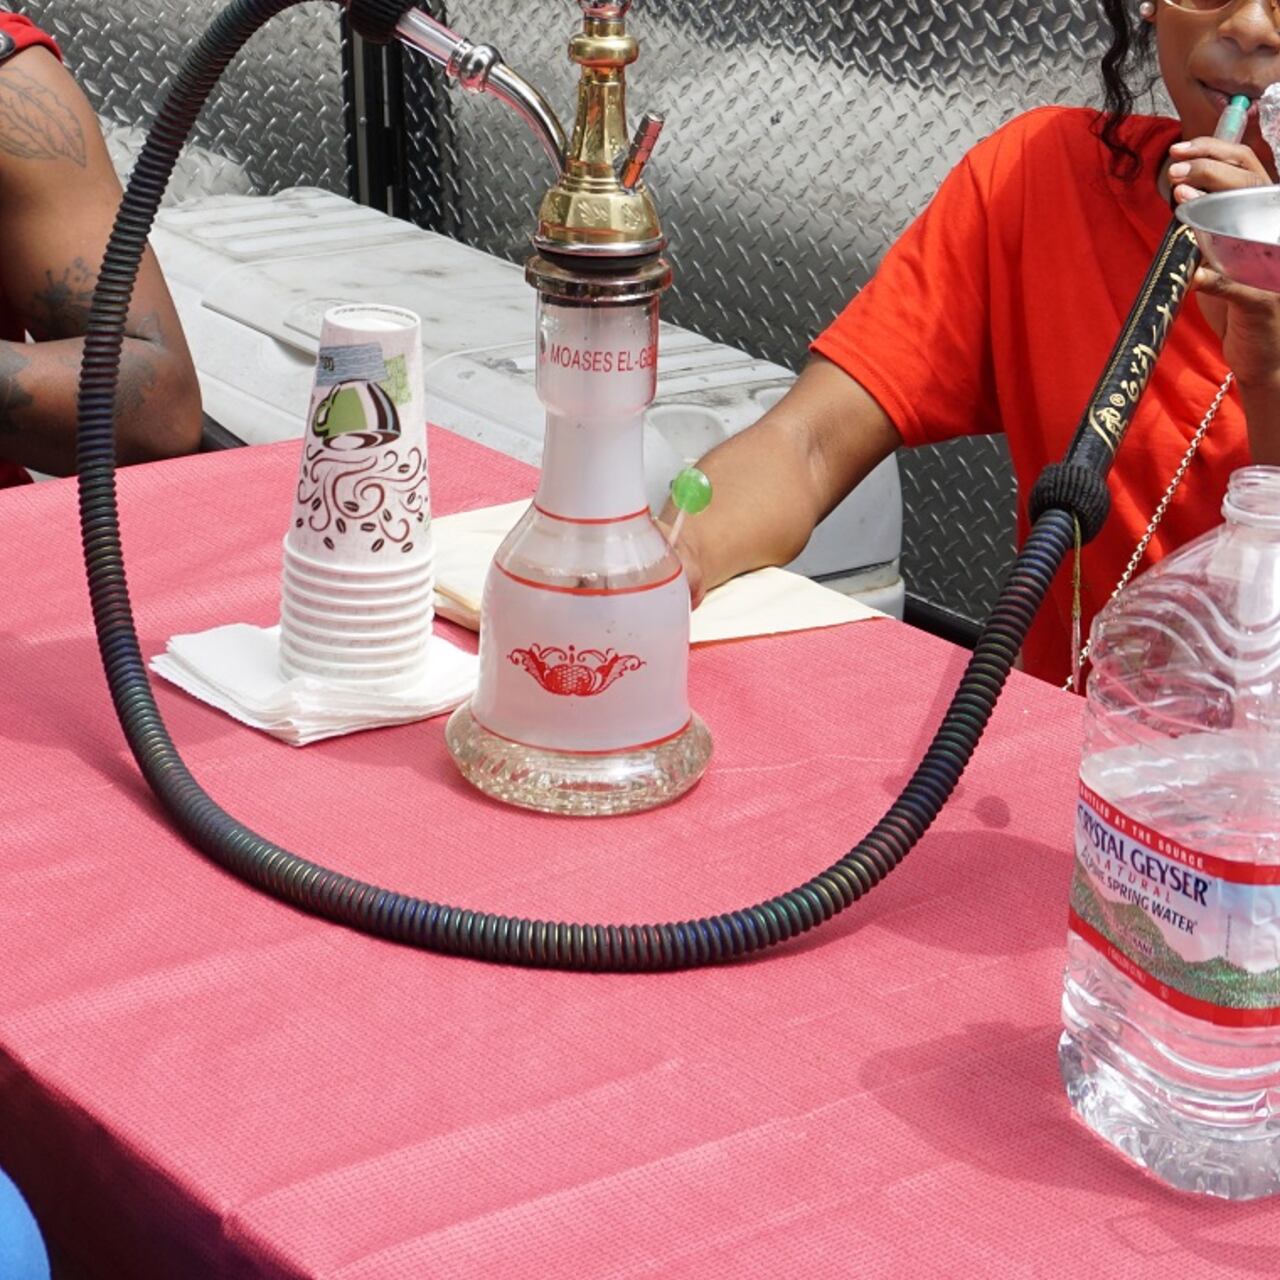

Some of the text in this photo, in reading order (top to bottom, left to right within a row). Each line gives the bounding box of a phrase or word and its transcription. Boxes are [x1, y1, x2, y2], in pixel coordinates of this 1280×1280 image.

[550, 342, 613, 373] MOASES
[1114, 815, 1127, 830] AT
[1132, 825, 1152, 845] THE
[1157, 839, 1205, 869] SOURCE
[1130, 847, 1209, 907] GEYSER
[1106, 876, 1149, 911] SPRING
[1151, 901, 1195, 936] WATER
